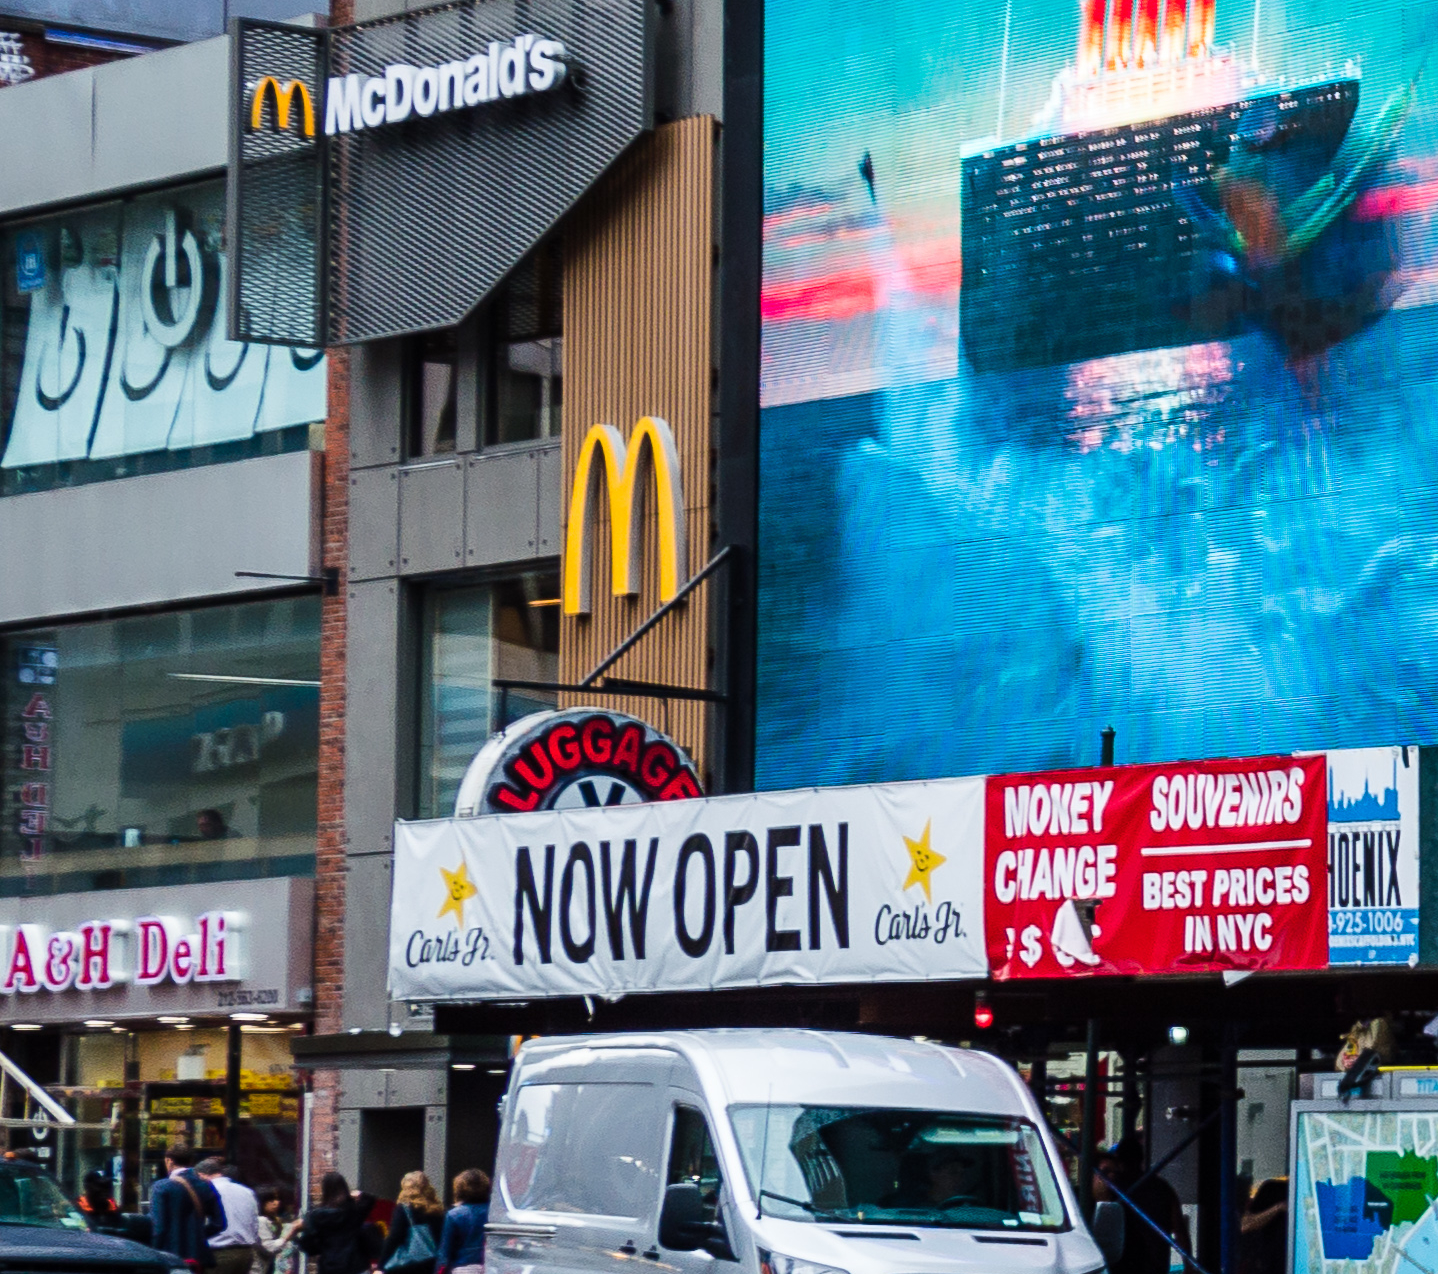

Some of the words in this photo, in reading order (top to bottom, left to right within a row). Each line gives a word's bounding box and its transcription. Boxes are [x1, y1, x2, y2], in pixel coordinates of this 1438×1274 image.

[325, 33, 568, 136] McDonald's
[1004, 780, 1115, 839] MONEY
[1149, 766, 1306, 833] SOUVENIRS
[513, 836, 659, 966] NOW
[673, 821, 850, 959] OPEN
[995, 844, 1117, 904] CHANGE
[1142, 870, 1208, 911] BEST
[1212, 866, 1311, 908] PRICES
[1328, 829, 1402, 909] HOENIX
[406, 928, 460, 969] Carl's
[461, 925, 496, 966] Jr.
[874, 902, 931, 946] Carl's
[933, 899, 968, 944] Jr.
[1185, 916, 1215, 953] IN
[1216, 912, 1274, 953] NYC
[1328, 911, 1404, 933] -925-1006
[4, 924, 113, 990] A&H
[135, 915, 228, 984] Deli
